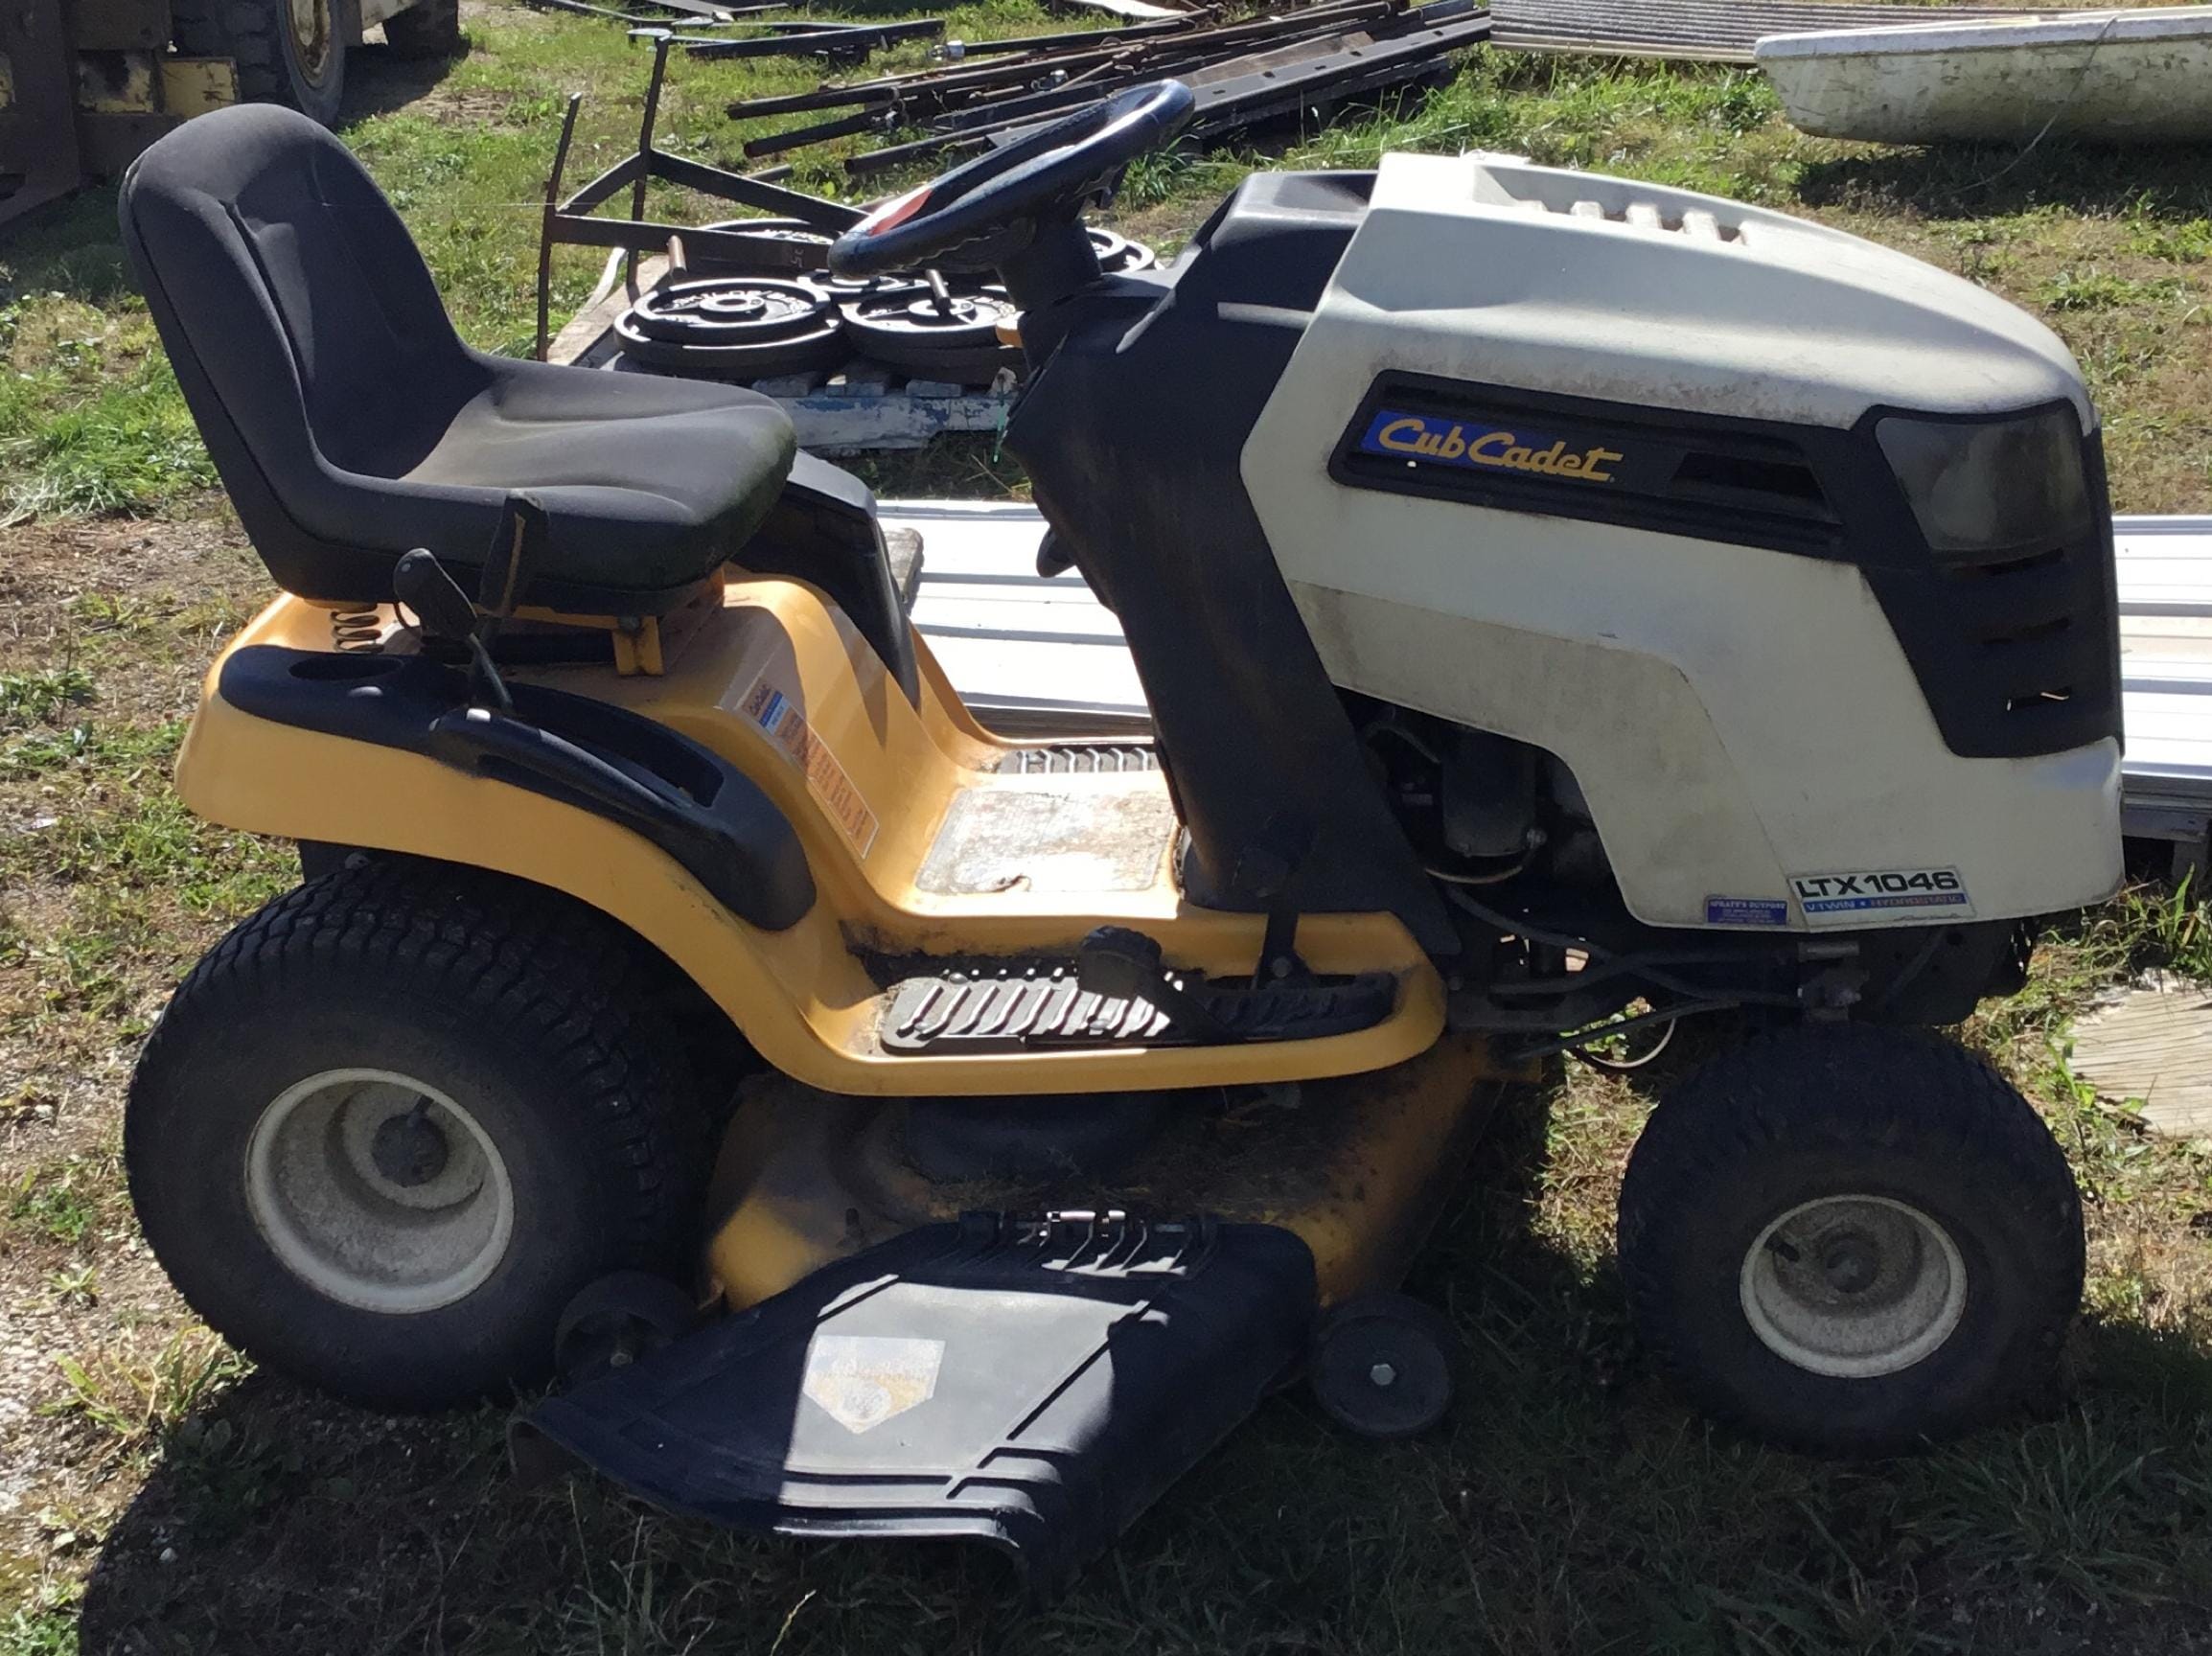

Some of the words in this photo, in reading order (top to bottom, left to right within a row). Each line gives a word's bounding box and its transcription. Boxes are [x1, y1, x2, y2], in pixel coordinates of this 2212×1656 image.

[1379, 419, 1465, 459] Cub
[1468, 432, 1624, 482] Cadet
[1795, 871, 1960, 898] LTX1046
